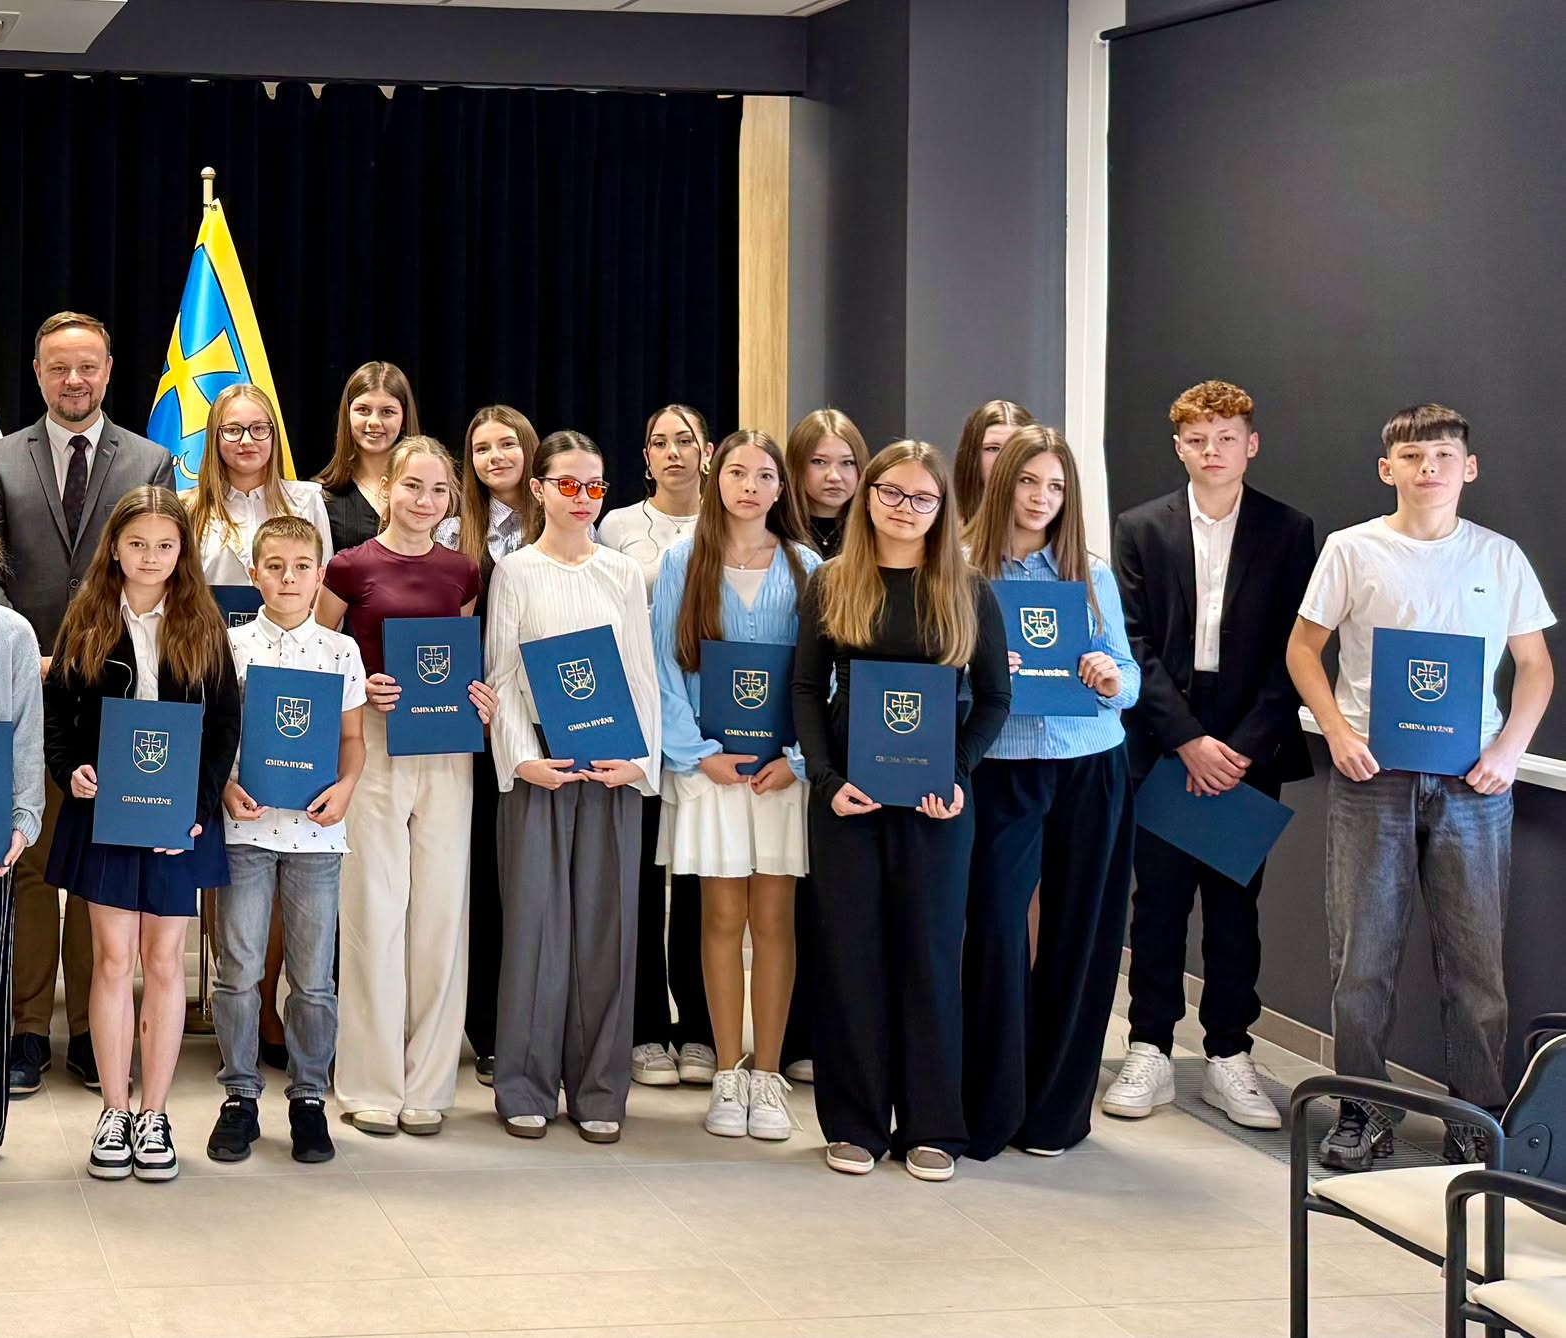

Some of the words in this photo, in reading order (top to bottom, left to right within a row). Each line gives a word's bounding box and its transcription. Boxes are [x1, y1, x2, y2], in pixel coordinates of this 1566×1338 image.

[411, 706, 435, 714] GMINA
[435, 705, 459, 713] HYŻNE
[567, 722, 591, 732] GMINA
[1398, 722, 1426, 731] GMINA
[1426, 725, 1454, 734] HYŻNE
[724, 728, 749, 736] GMINA
[749, 730, 774, 738] HYŻNE
[265, 758, 289, 767] GMINA
[121, 795, 146, 804] GMINA
[147, 796, 172, 805] HYŻNE
